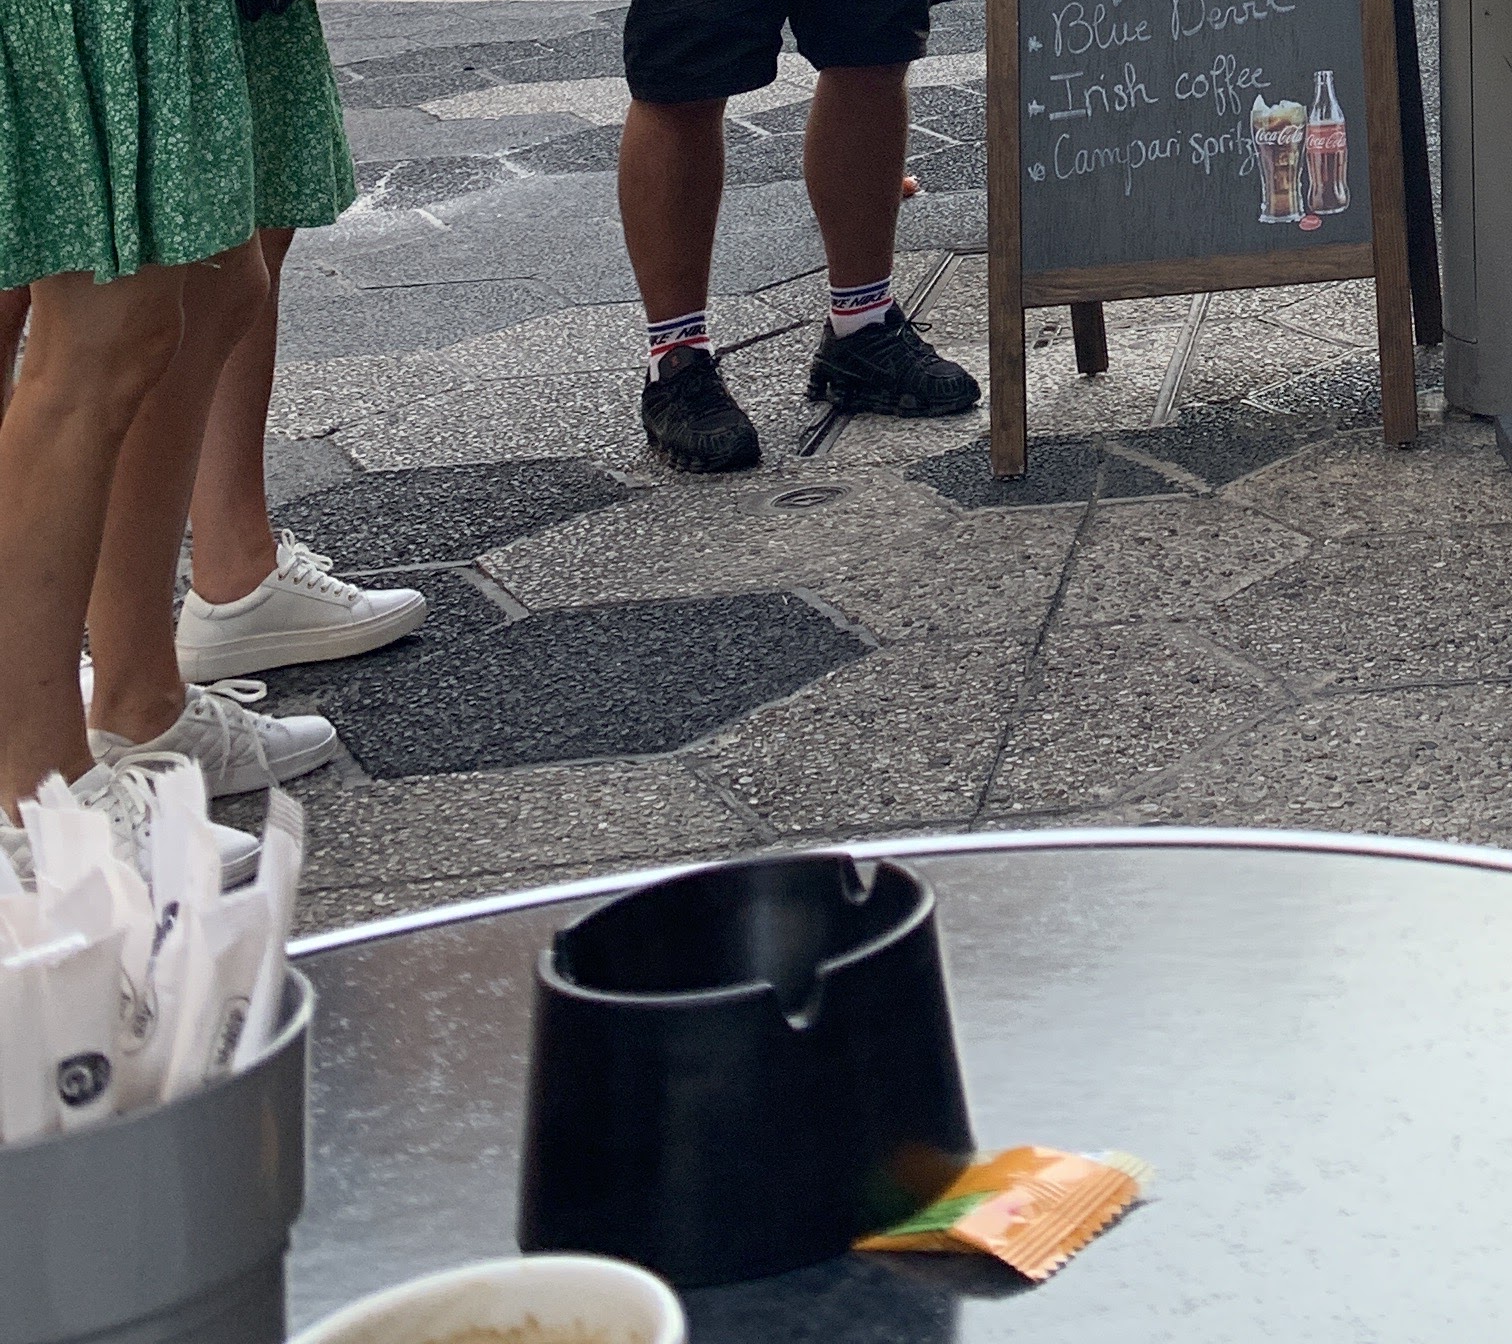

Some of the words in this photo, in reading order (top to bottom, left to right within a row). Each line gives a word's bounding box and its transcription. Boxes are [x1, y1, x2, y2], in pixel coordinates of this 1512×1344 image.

[1051, 1, 1152, 57] Blue
[1049, 62, 1160, 120] Irish
[1174, 54, 1271, 117] coffee
[1053, 129, 1182, 197] Campari
